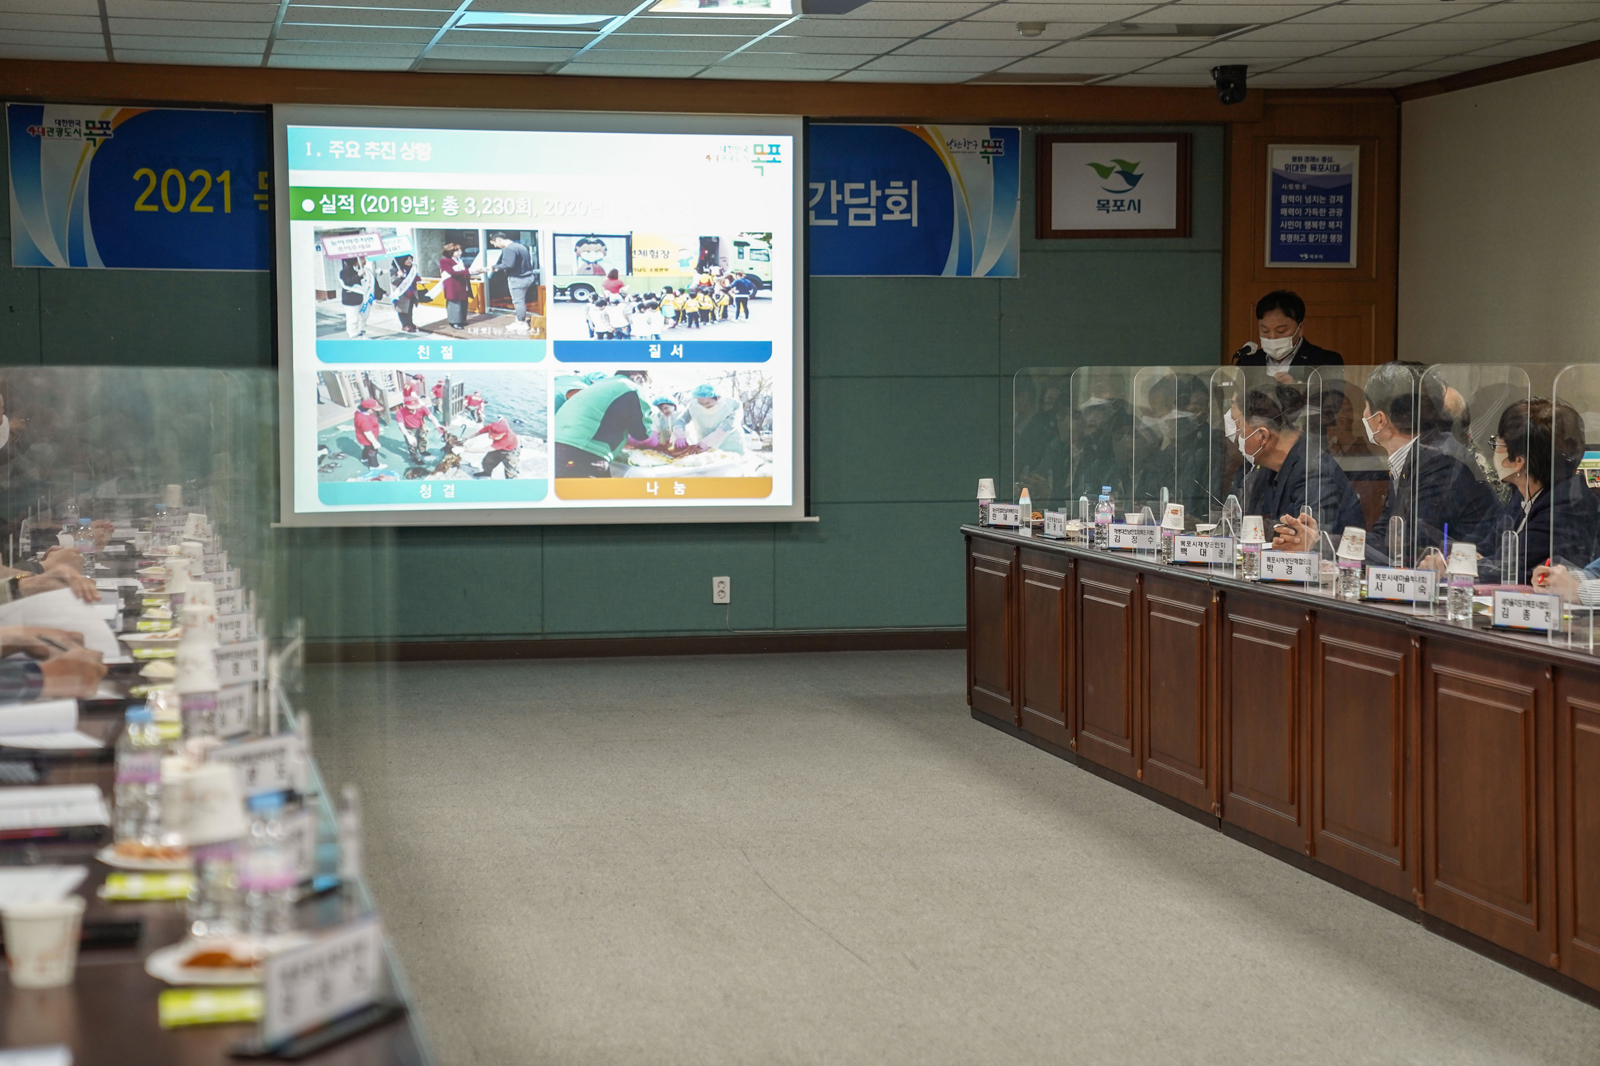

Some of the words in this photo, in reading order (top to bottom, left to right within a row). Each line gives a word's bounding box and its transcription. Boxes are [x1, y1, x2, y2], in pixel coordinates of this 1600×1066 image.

[54, 119, 82, 128] 대한민국
[26, 125, 82, 138] 4대관광도시
[83, 119, 114, 148] 목포
[329, 140, 361, 159] 주요
[364, 141, 396, 160] 추진
[400, 142, 432, 161] 상황
[979, 139, 1004, 165] 목포
[751, 144, 782, 177] 목포
[1284, 164, 1307, 172] 위대한
[1310, 164, 1340, 173] 목포시대
[132, 168, 232, 214] 2021
[319, 194, 355, 214] 실적
[360, 194, 436, 216] (2019년:
[442, 195, 460, 216] 총
[464, 196, 538, 218] 3,230회,
[809, 180, 918, 228] 간담회
[1096, 199, 1142, 214] 목포시
[1281, 195, 1302, 204] 활력이
[1305, 195, 1326, 204] 넘치는
[1328, 195, 1343, 204] 경제
[1280, 208, 1302, 217] 매력이
[1304, 208, 1326, 217] 가득한
[1328, 208, 1343, 217] 관광
[1280, 221, 1302, 230] 시민이
[1304, 221, 1326, 230] 행복한
[1328, 221, 1342, 230] 복지
[1329, 234, 1343, 243] 행정
